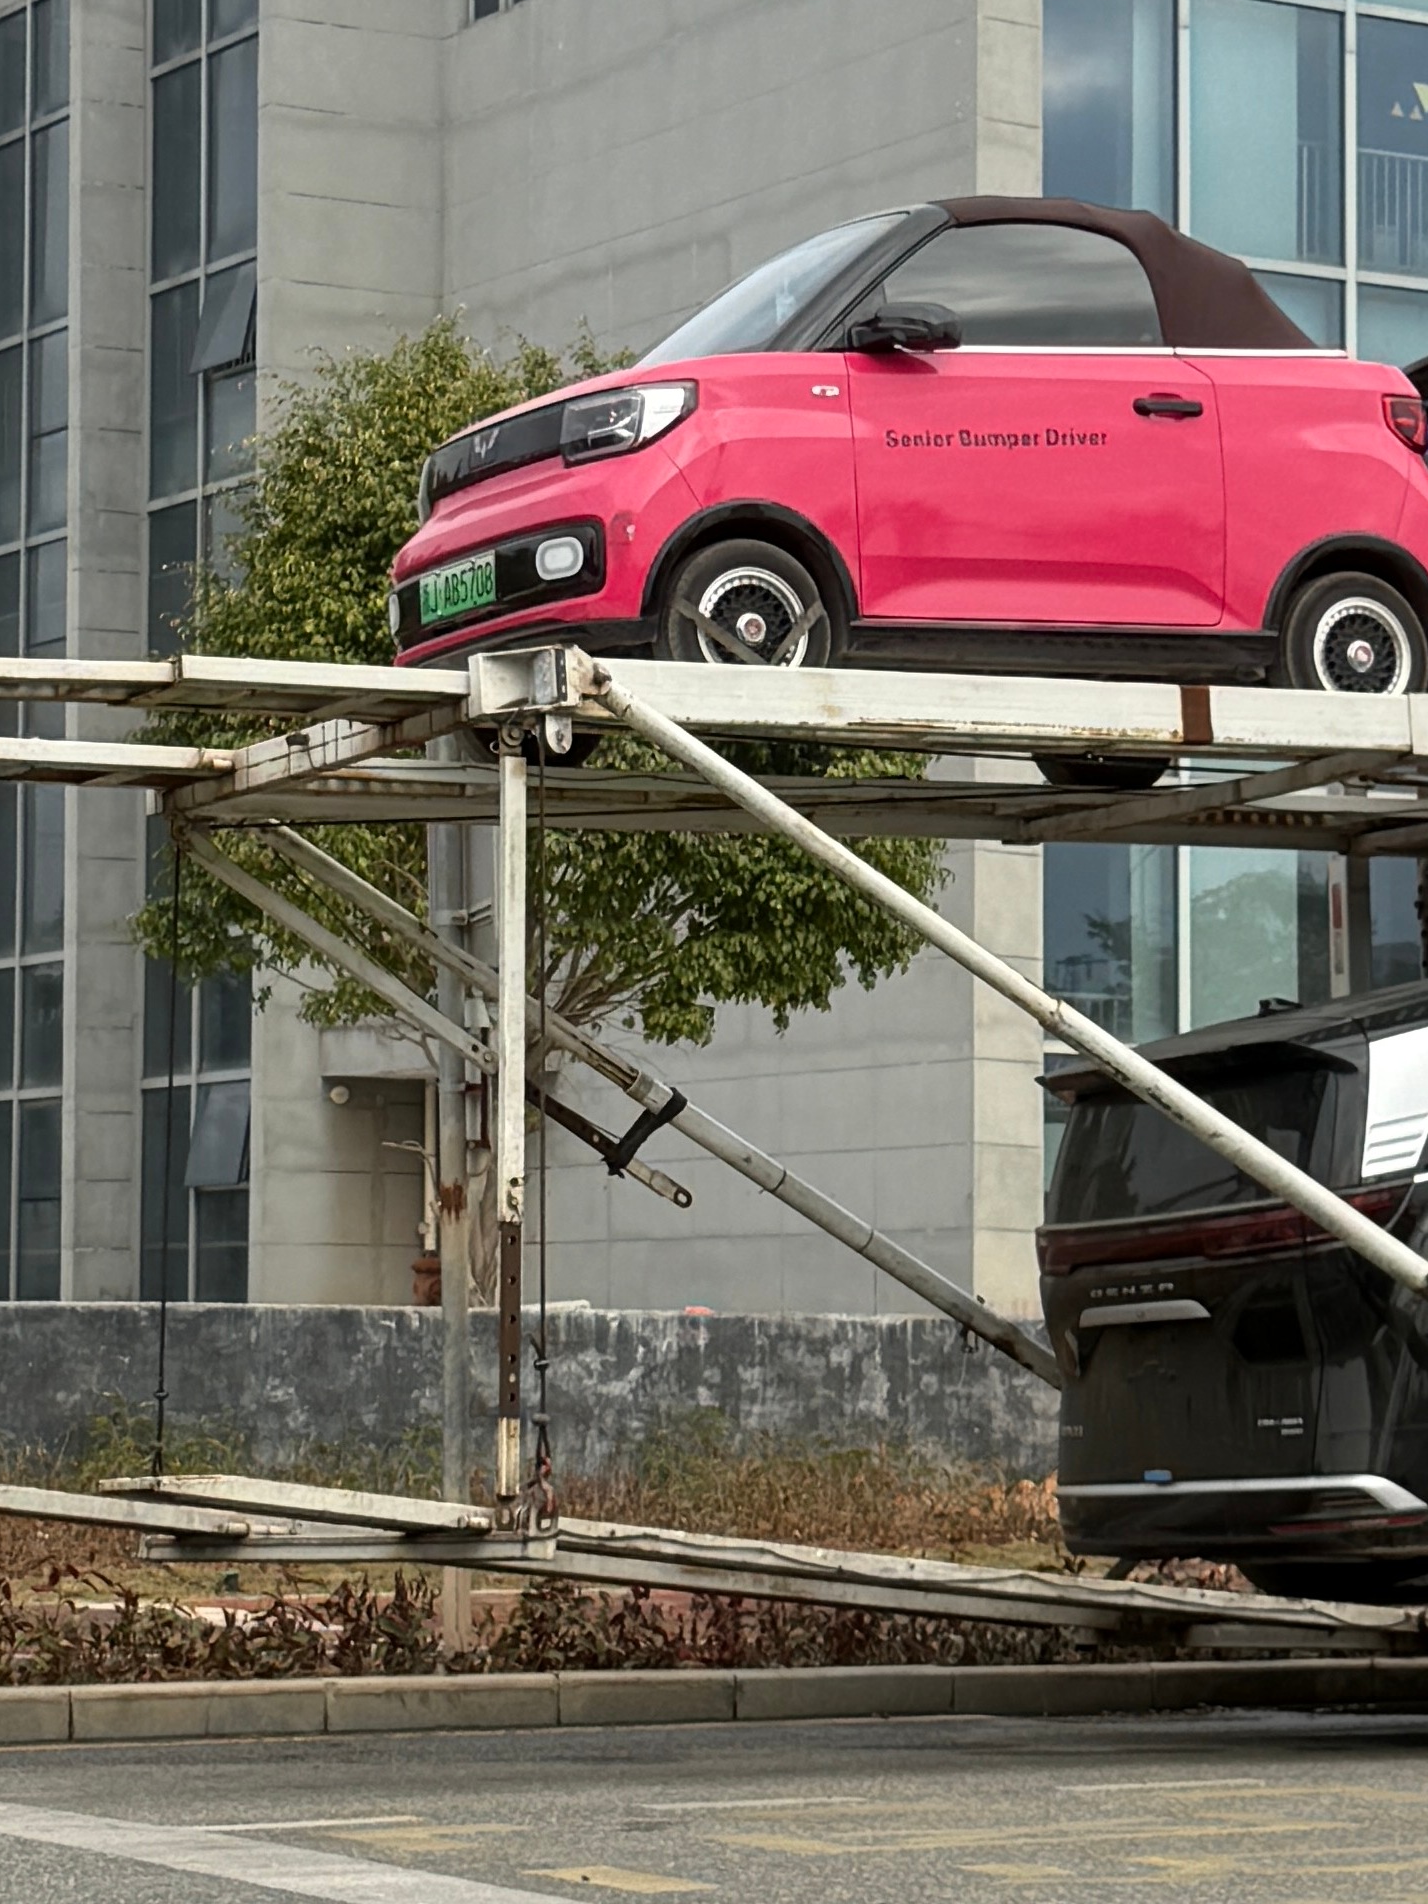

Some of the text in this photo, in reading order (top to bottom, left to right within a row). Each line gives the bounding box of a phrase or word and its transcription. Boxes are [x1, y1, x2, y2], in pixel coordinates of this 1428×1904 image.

[885, 427, 1108, 450] Senior Bumper Driver
